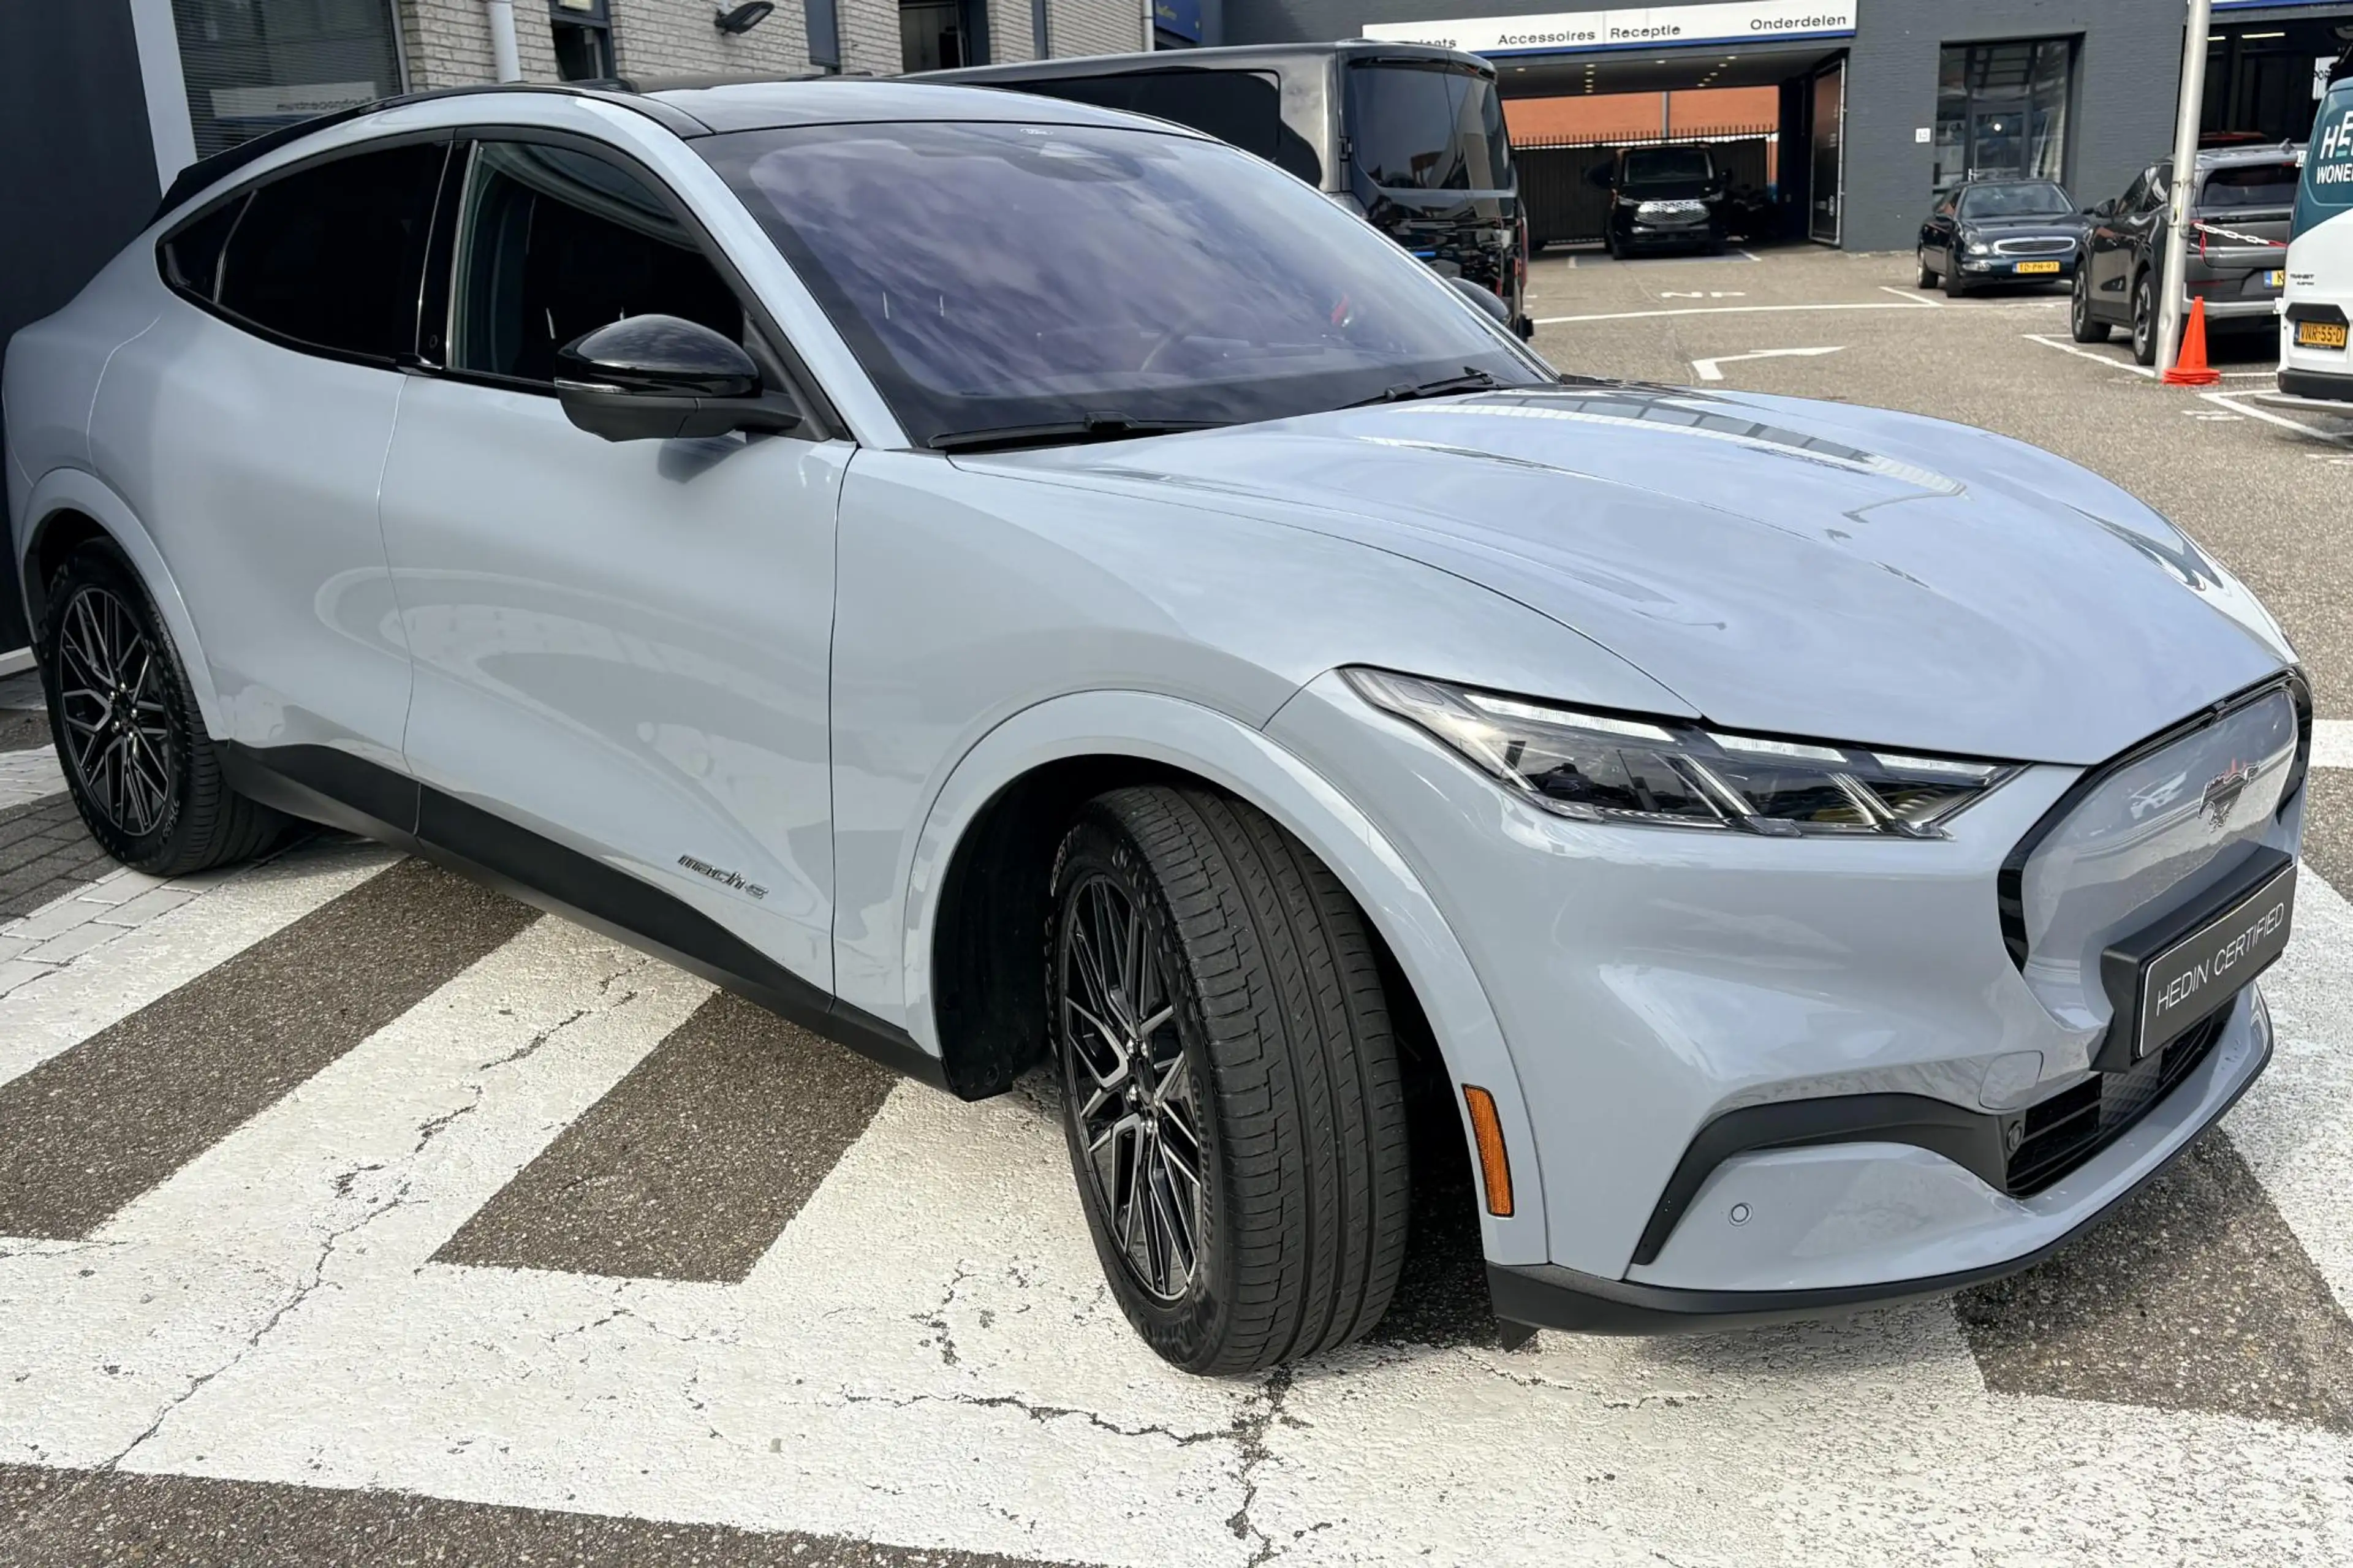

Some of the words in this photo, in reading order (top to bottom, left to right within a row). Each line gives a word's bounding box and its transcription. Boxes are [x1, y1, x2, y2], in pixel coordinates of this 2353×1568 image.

[1610, 24, 1681, 39] Receptie
[1750, 14, 1847, 31] Onderdelen
[1498, 30, 1596, 45] Accessoires
[2319, 110, 2353, 160] HE
[2316, 163, 2353, 184] WONE
[2300, 324, 2343, 343] VNR-55-D
[2156, 960, 2210, 1017] HEDIN
[2214, 903, 2284, 975] CERTIFIED
